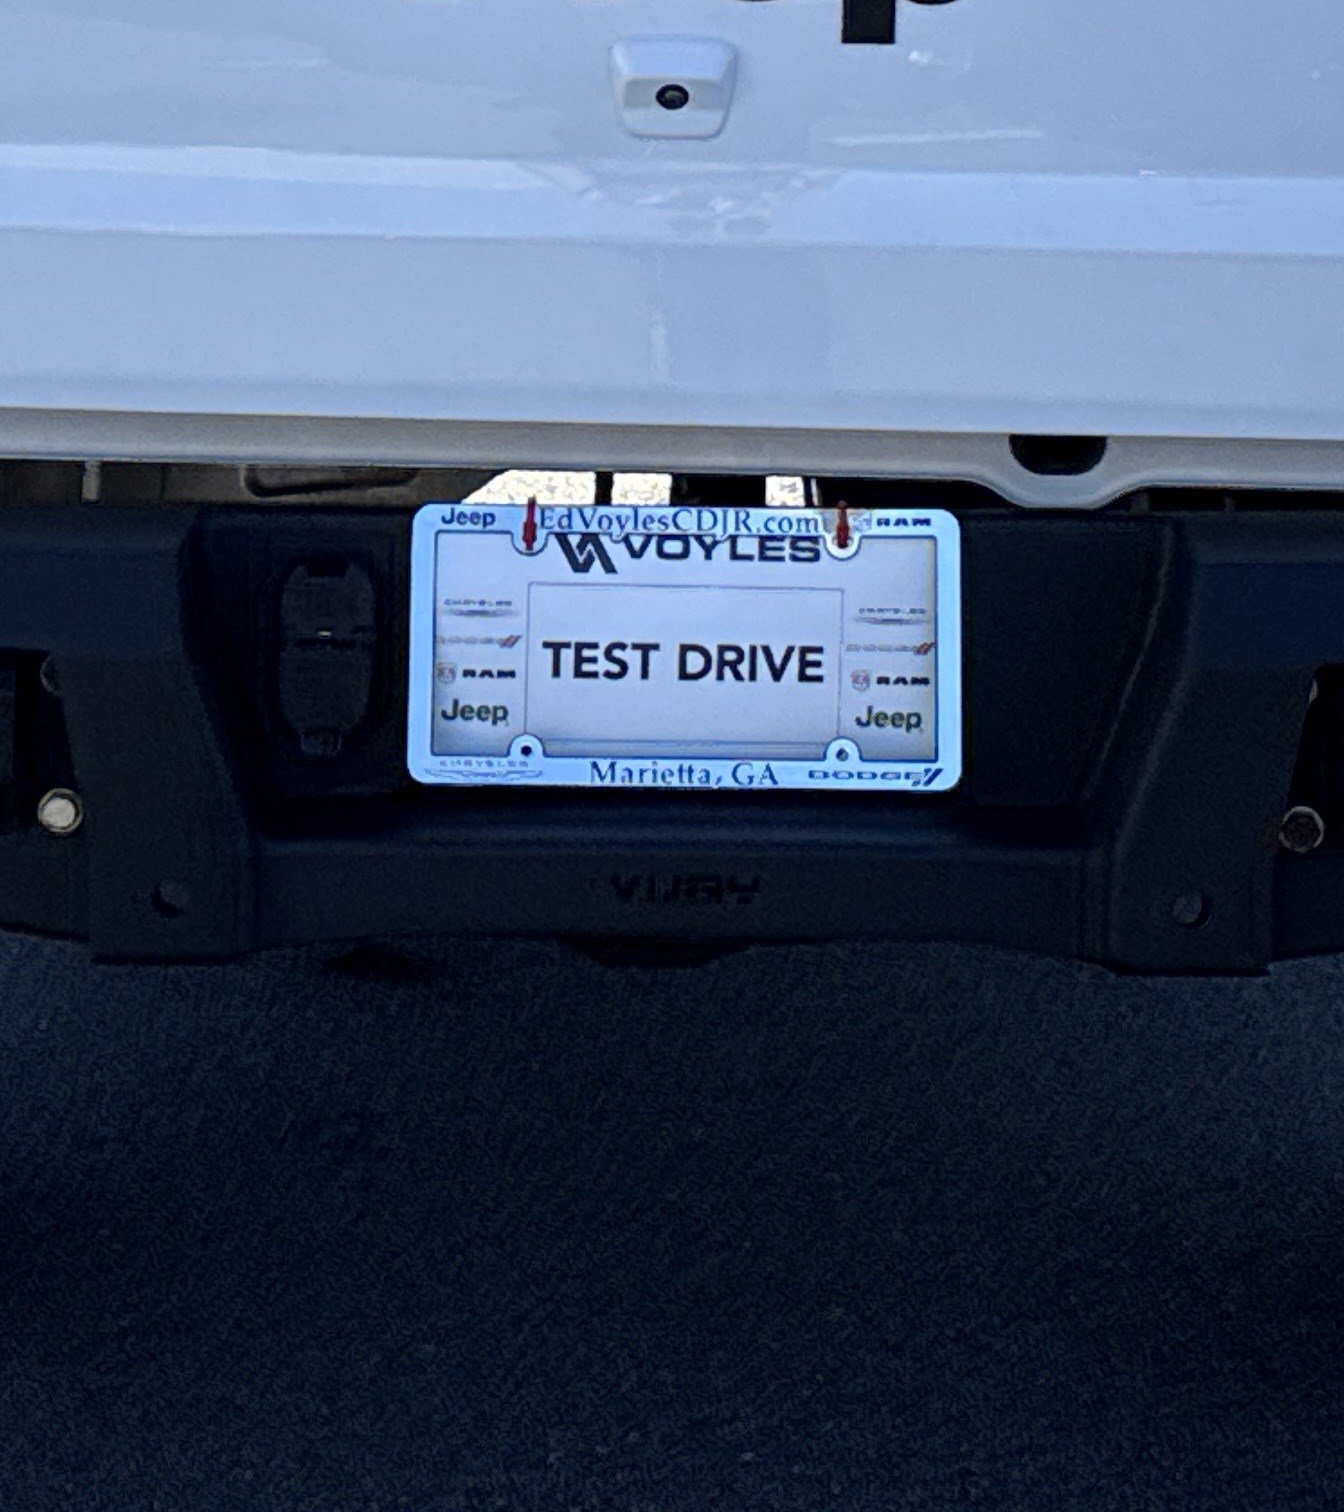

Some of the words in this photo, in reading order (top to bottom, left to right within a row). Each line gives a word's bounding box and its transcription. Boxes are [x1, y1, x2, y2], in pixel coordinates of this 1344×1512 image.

[440, 507, 496, 529] Jeep
[539, 507, 819, 537] EdVoylesCDJR.com
[876, 517, 932, 527] RAM
[620, 534, 822, 563] VOYLES
[462, 668, 517, 679] RAM
[542, 641, 660, 681] TEST
[677, 644, 825, 683] DRIVE
[876, 675, 931, 687] RAM
[441, 698, 509, 726] Jeep
[855, 705, 923, 733] Jeep
[590, 760, 723, 786] Marietta,
[731, 762, 779, 786] GA
